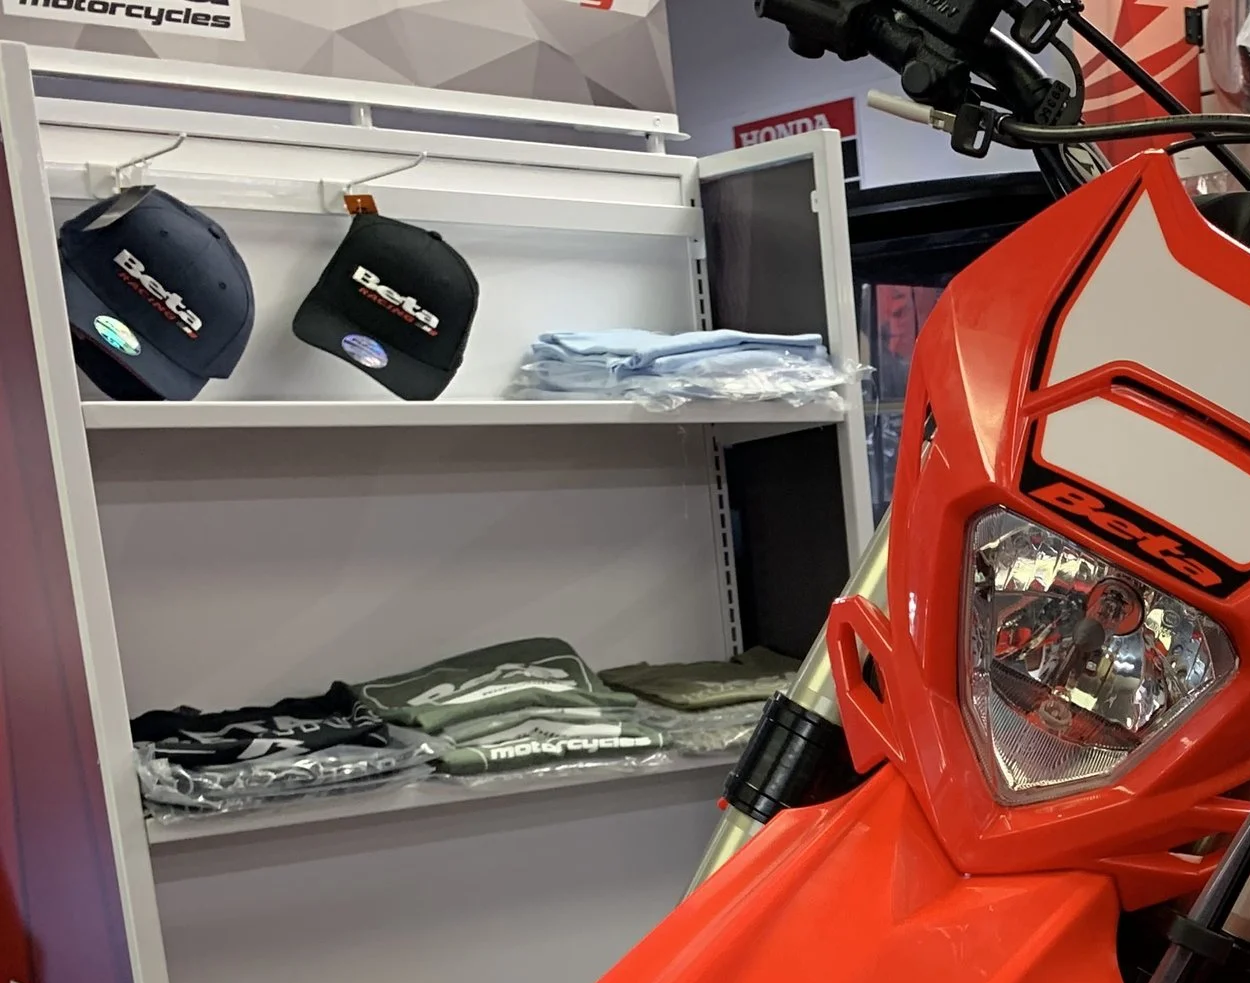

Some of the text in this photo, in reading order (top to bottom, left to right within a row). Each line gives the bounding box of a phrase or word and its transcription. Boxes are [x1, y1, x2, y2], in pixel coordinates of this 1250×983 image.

[740, 113, 832, 148] HONDA
[113, 249, 203, 331] Beta
[351, 265, 440, 329] Beta
[1028, 482, 1222, 587] Beta
[490, 735, 653, 761] motorcycles
